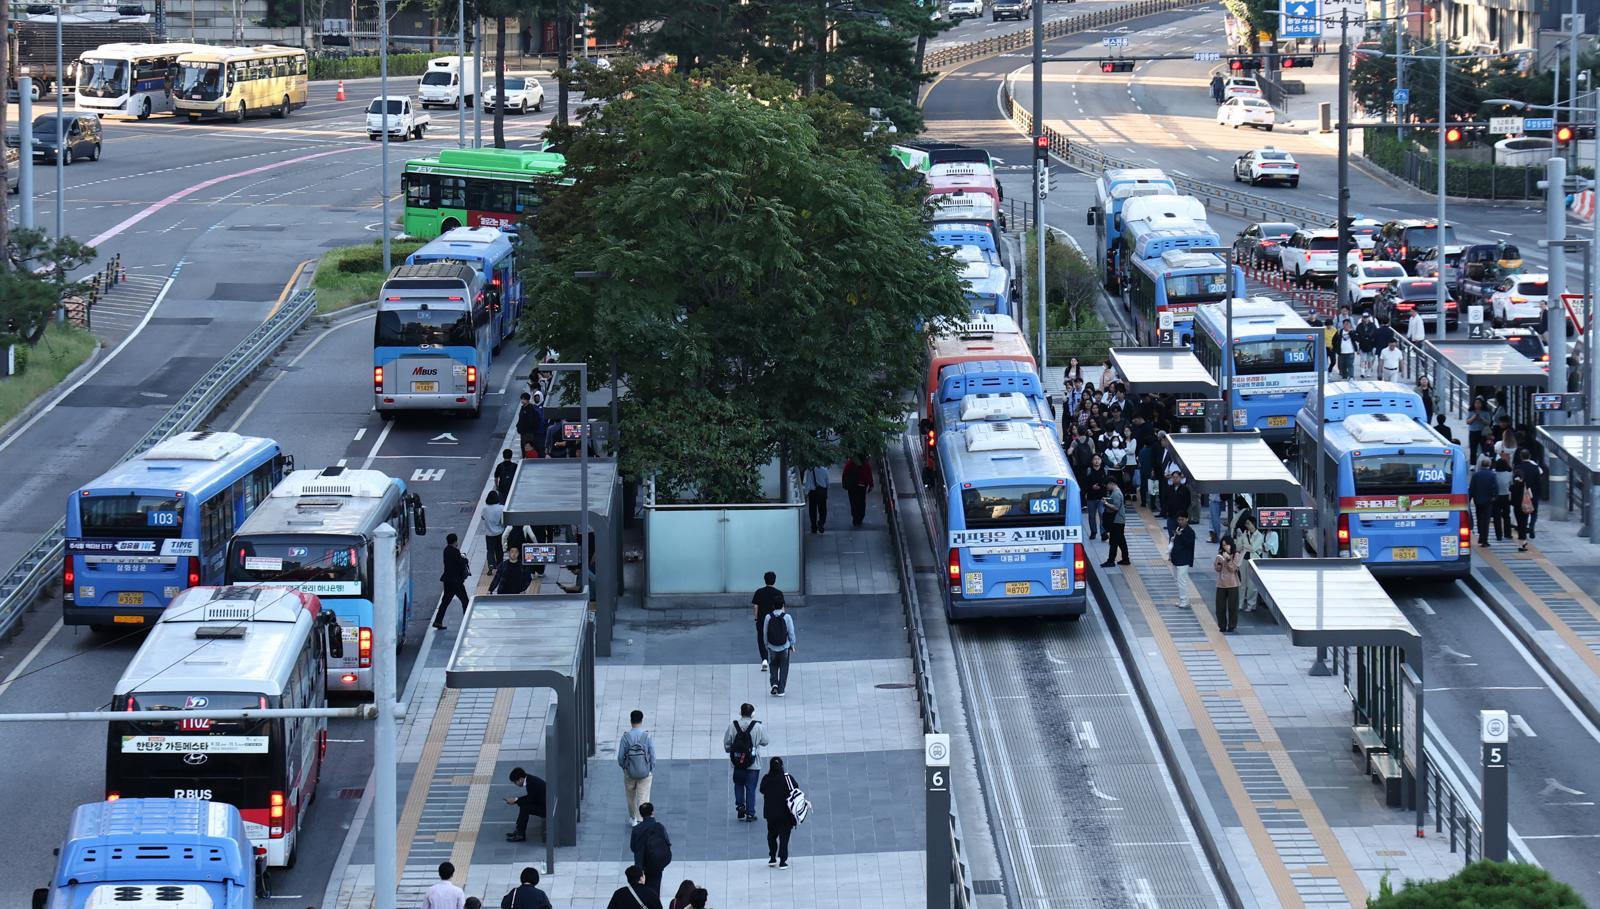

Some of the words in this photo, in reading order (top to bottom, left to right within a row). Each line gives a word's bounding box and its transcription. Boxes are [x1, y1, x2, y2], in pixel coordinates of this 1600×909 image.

[1210, 284, 1227, 292] 202
[1472, 326, 1480, 335] 4
[1163, 332, 1170, 341] 5
[1288, 352, 1305, 361] 150
[1418, 470, 1446, 481] 750A
[1032, 499, 1057, 513] 463
[152, 513, 173, 524] 103
[171, 541, 194, 549] TIME
[136, 741, 163, 752] 한탄강
[1490, 747, 1502, 763] 5
[932, 771, 944, 787] 6
